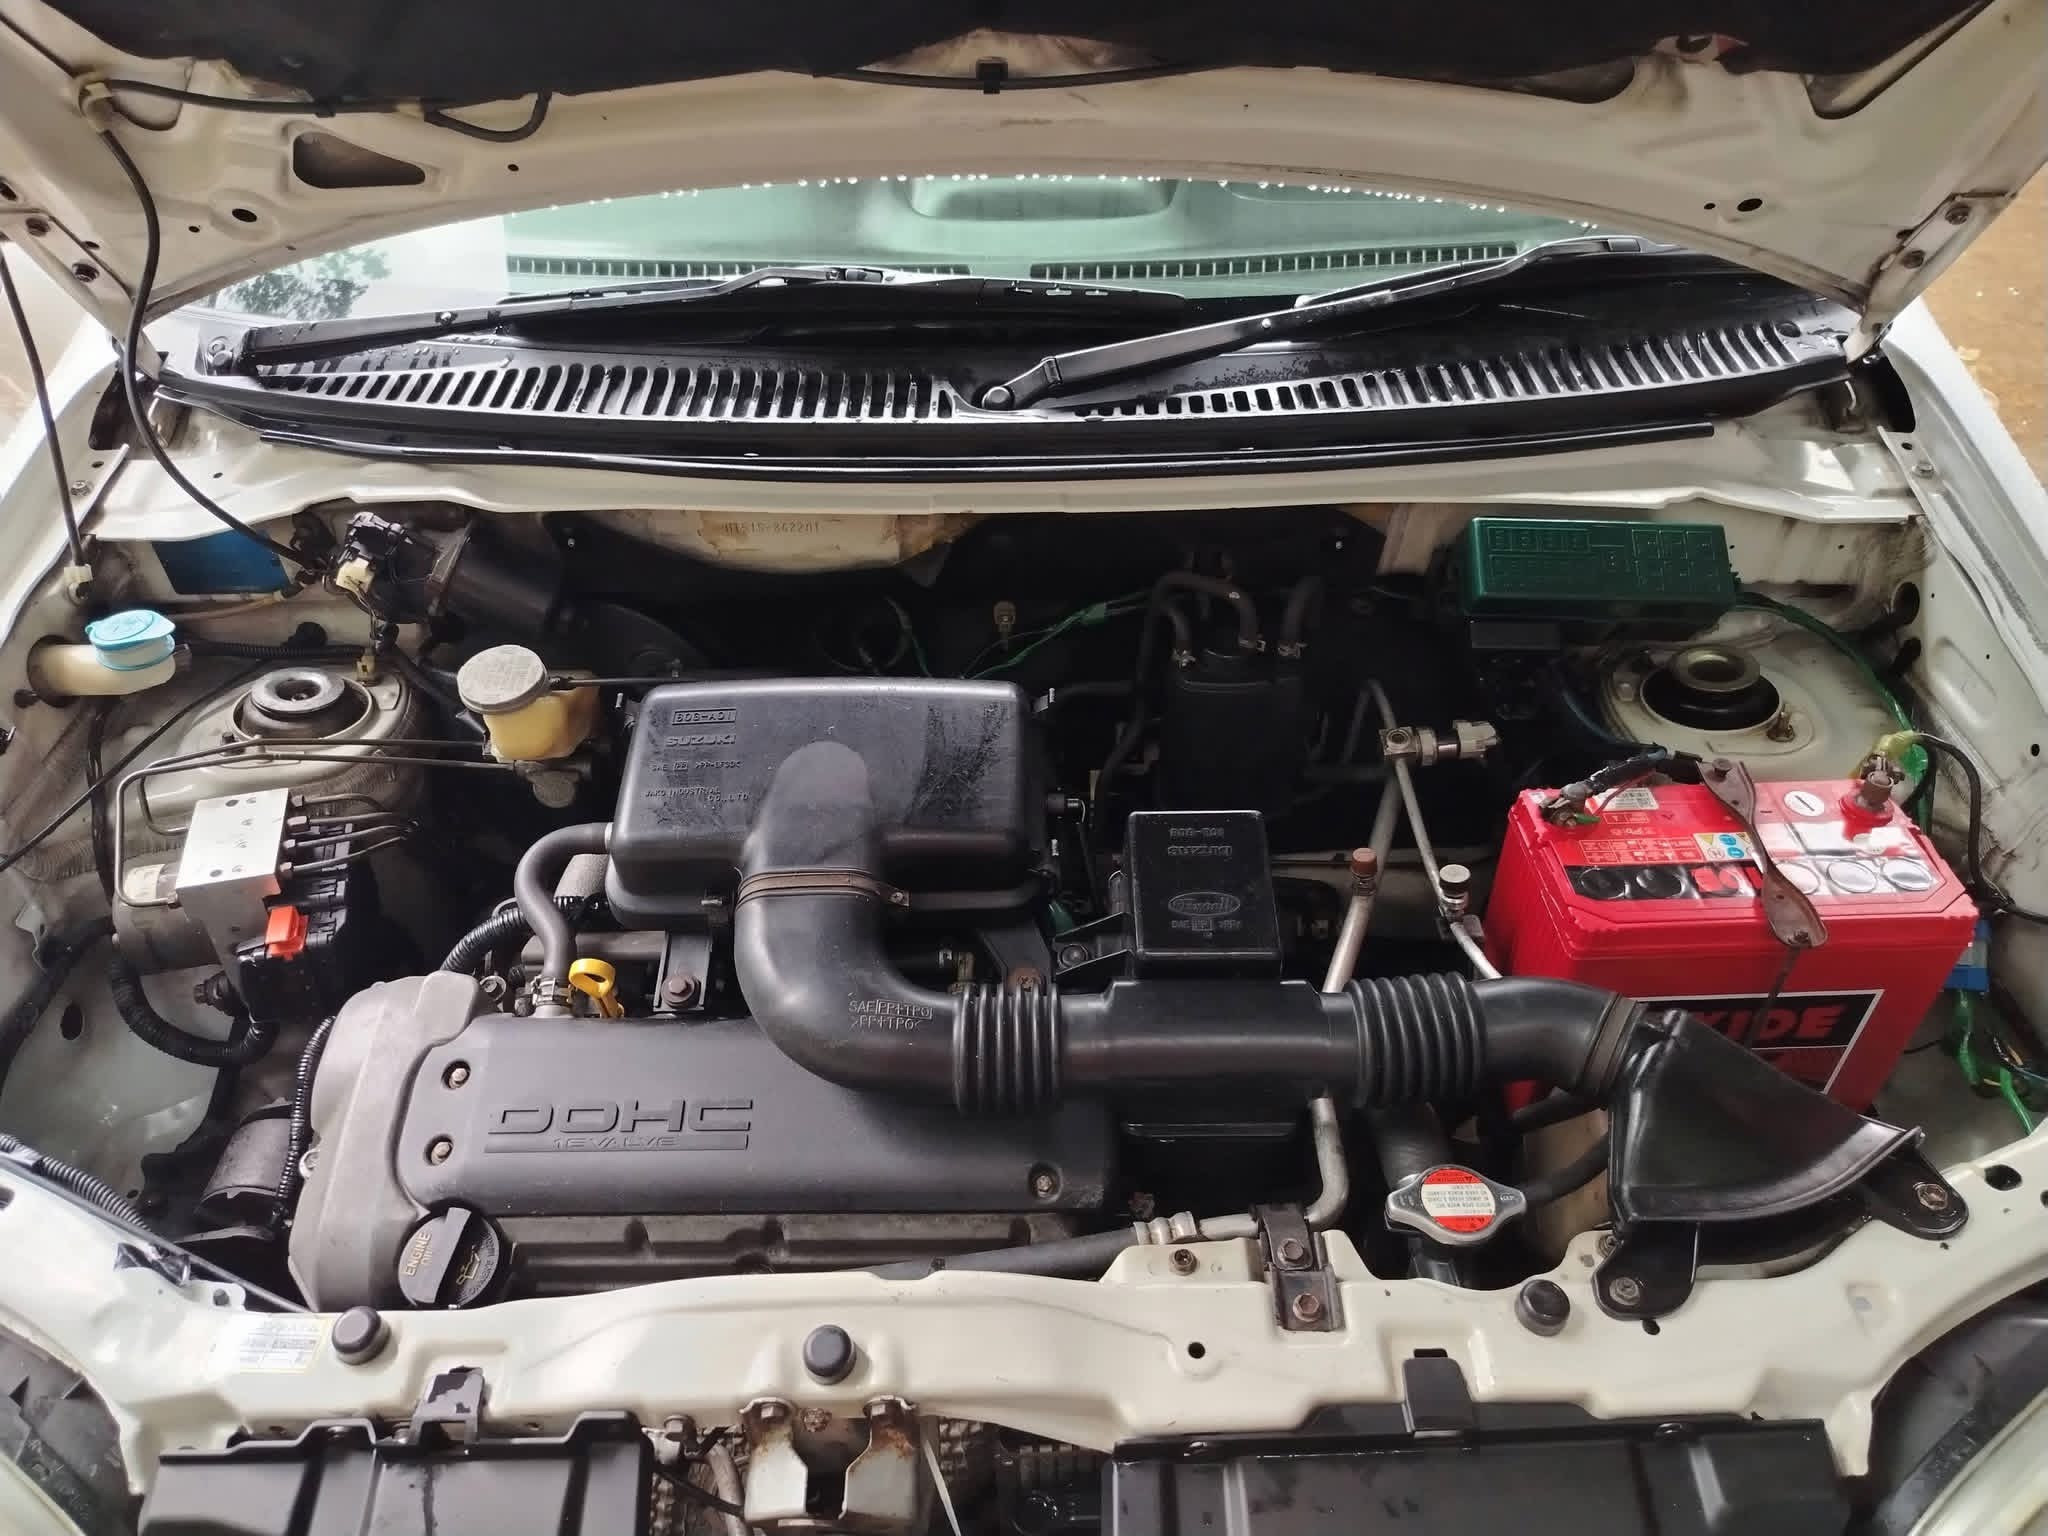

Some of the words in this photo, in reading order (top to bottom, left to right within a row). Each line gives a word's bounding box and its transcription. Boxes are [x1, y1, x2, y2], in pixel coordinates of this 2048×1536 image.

[665, 734, 737, 747] SUZUKI
[848, 1000, 876, 1015] SAE
[488, 1099, 754, 1134] DOHC
[405, 1231, 432, 1277] ENGINE
